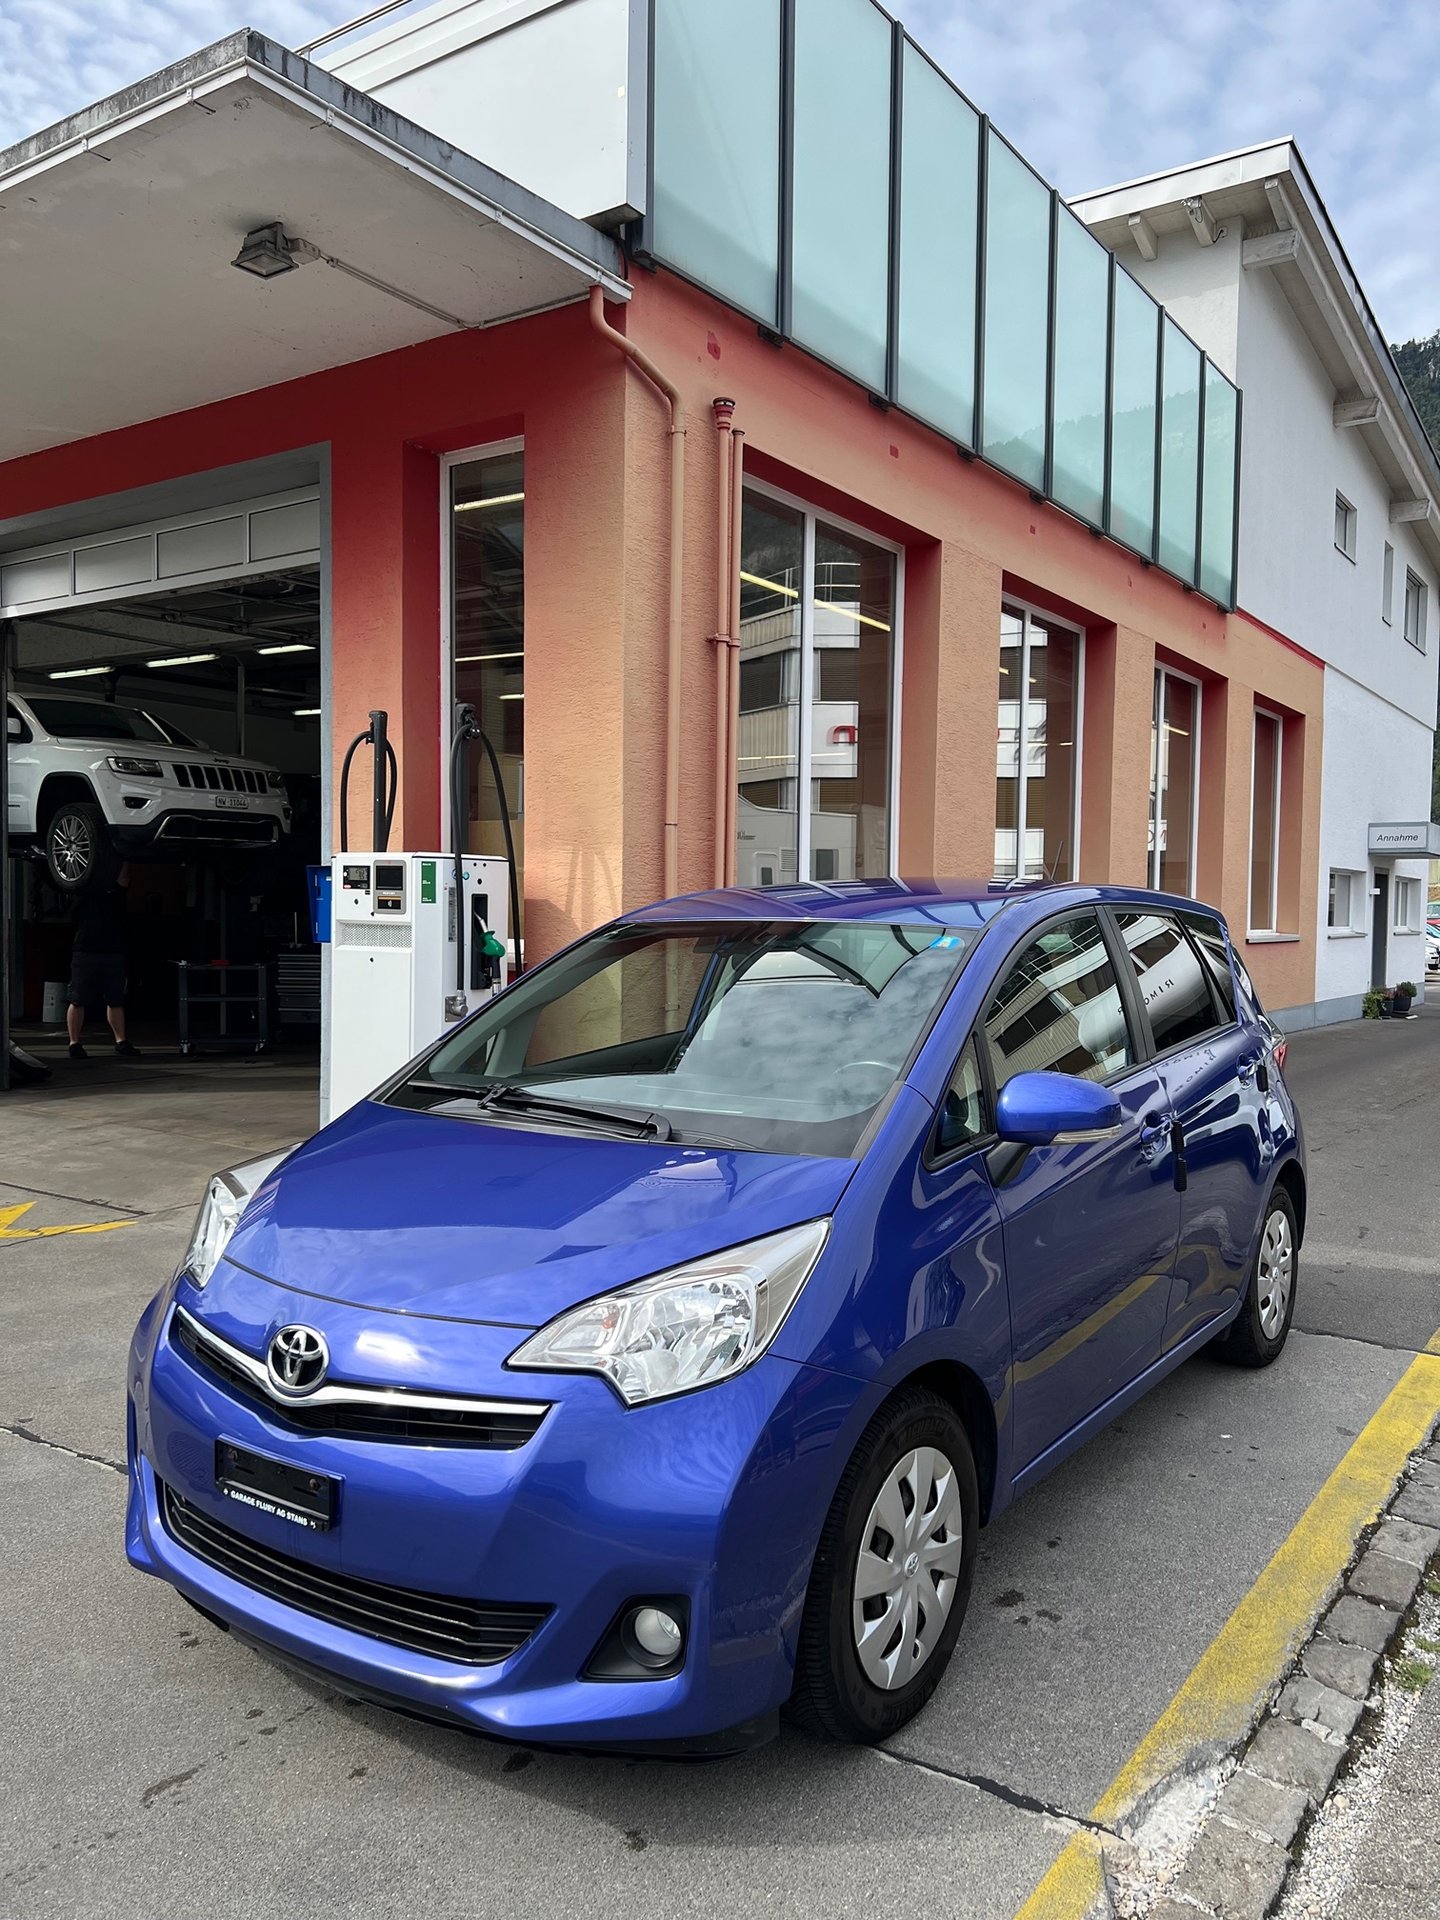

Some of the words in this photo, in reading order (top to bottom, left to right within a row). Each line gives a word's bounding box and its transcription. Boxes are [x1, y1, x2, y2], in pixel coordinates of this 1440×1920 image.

[1376, 834, 1419, 842] Annahme
[230, 1490, 256, 1506] GARAGE
[255, 1500, 276, 1514] FLURY
[276, 1508, 286, 1518] AG
[286, 1511, 308, 1526] STANS
